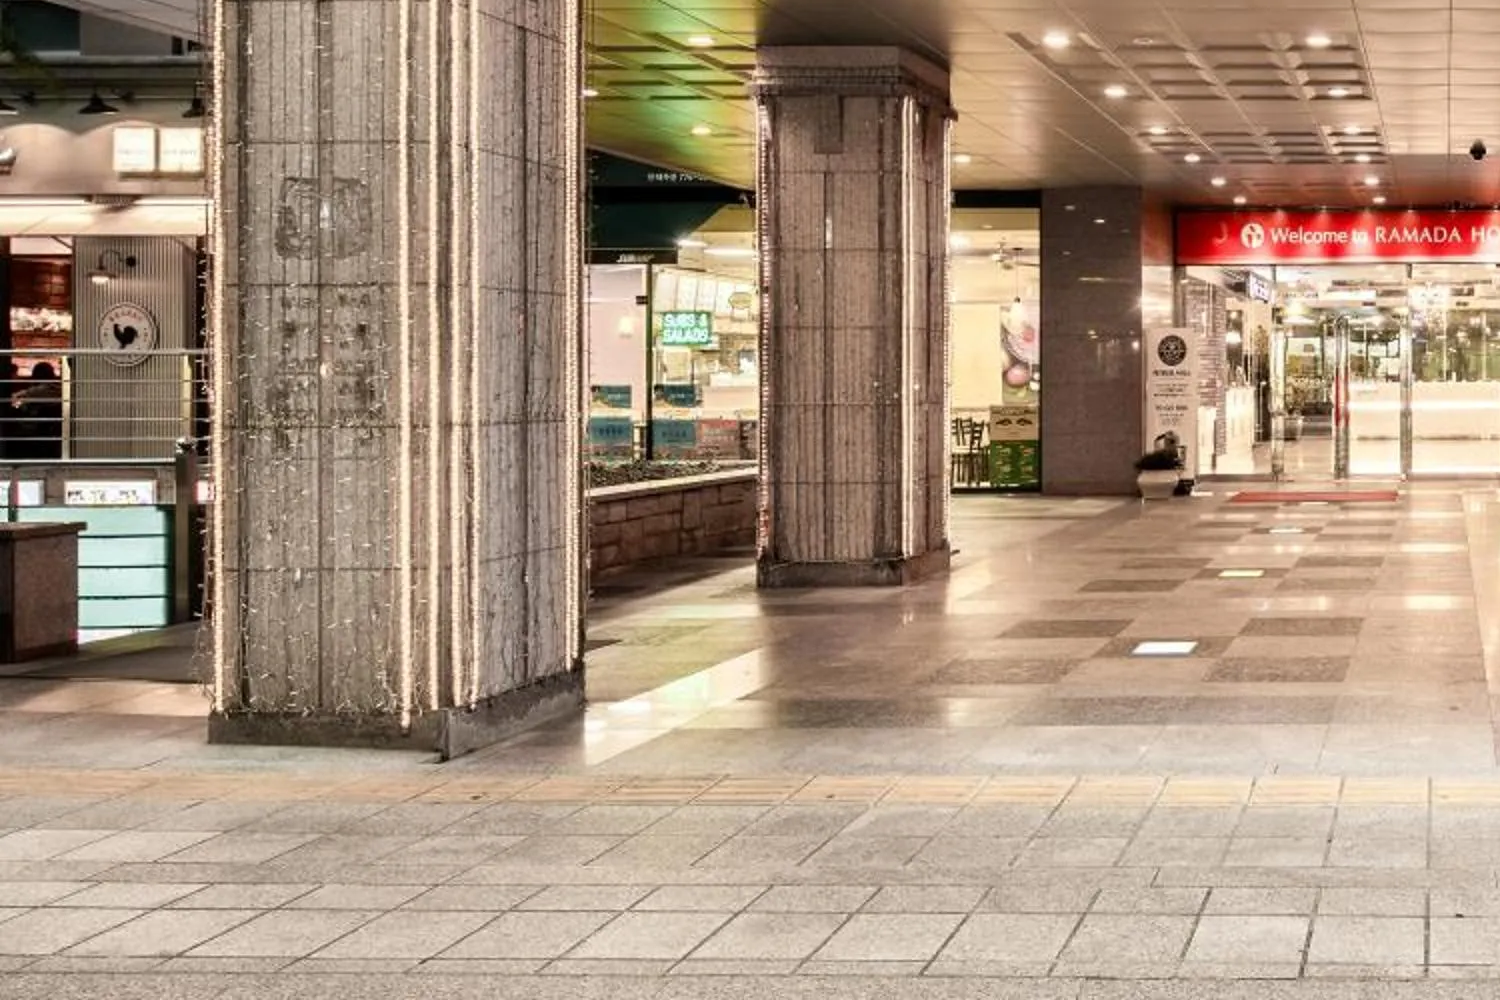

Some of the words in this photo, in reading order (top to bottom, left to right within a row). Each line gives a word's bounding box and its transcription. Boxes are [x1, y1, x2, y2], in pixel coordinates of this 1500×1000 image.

[1270, 226, 1348, 244] Welcome
[1351, 228, 1369, 244] to
[1375, 226, 1461, 243] RAMADA
